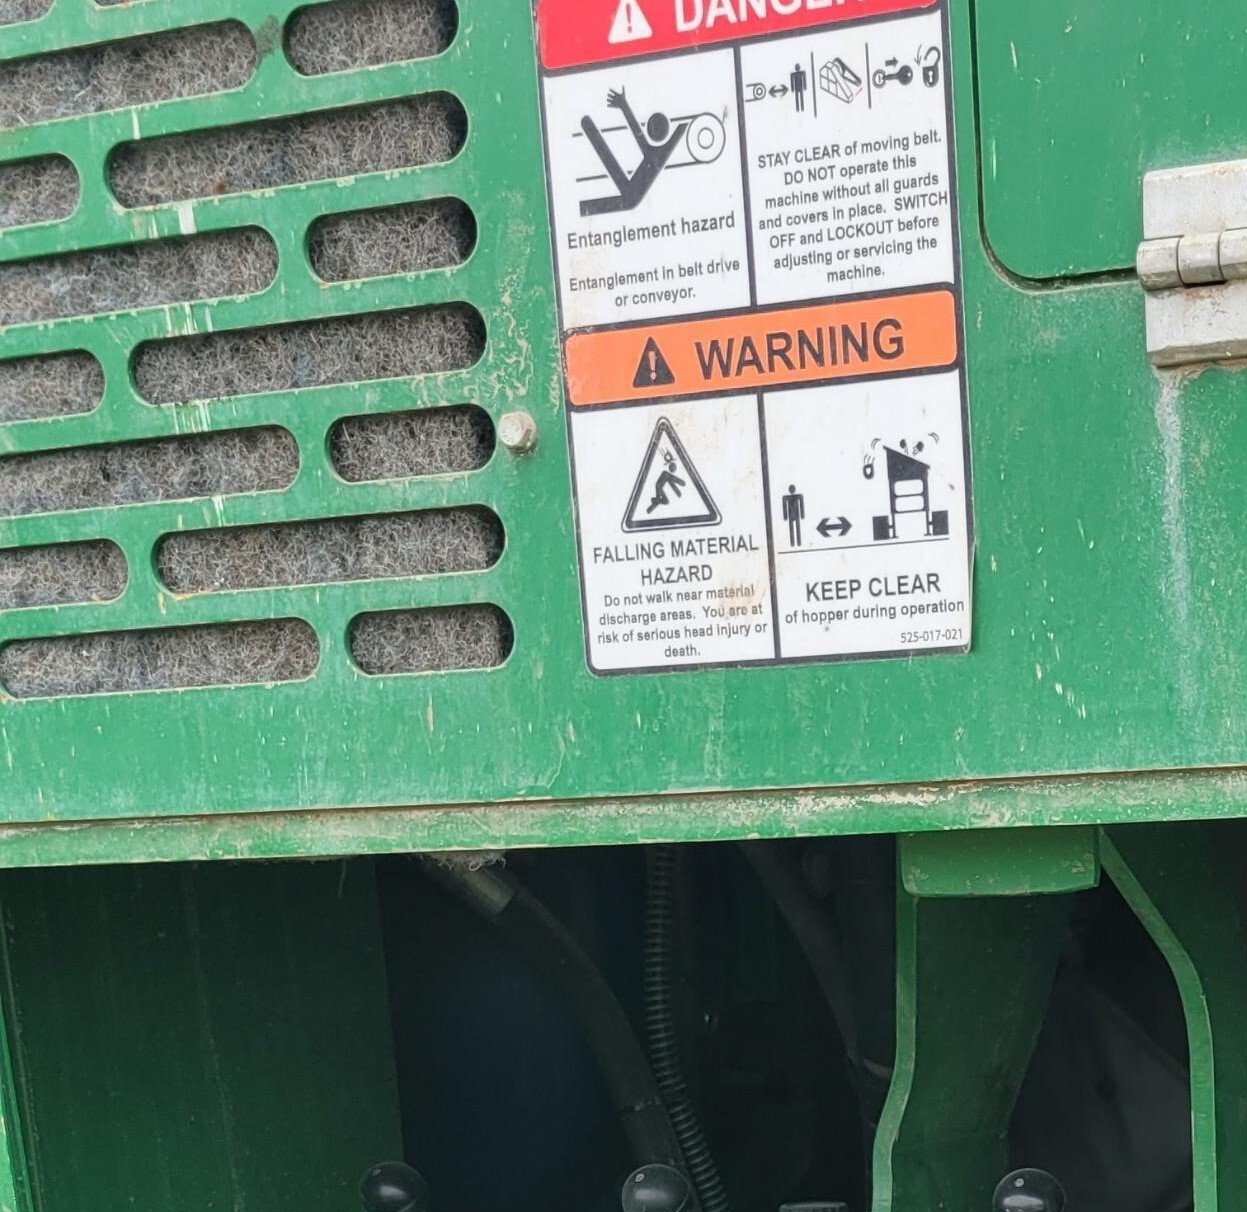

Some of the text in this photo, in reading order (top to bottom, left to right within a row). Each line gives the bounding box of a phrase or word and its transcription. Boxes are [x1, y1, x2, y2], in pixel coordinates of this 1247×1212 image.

[758, 130, 941, 169] STAY CLEAR of moving belt.
[784, 155, 917, 185] DO NOT operate this
[765, 173, 939, 209] machine without all guards
[759, 191, 948, 230] and covers in place. SWITCH
[567, 210, 735, 249] Entanglement hazard
[770, 216, 939, 249] OFF and LOCKOUT before
[774, 236, 937, 270] adjusting or servicing the
[569, 257, 740, 291] Entanglement in belt drive
[827, 264, 885, 283] machine.
[615, 287, 696, 307] or conveyor.
[694, 318, 905, 381] WARNING
[594, 534, 759, 564] FALLING MATERIAL
[641, 564, 713, 586] HAZARD
[806, 572, 941, 602] KEEP CLEAR
[604, 584, 755, 607] Do not walk near material
[599, 603, 763, 625] discharge areas. You are at
[785, 600, 965, 625] of hopper during operation
[597, 622, 768, 644] risk of serious head injury or
[901, 628, 962, 643] 525-017-021
[665, 644, 701, 657] death.
